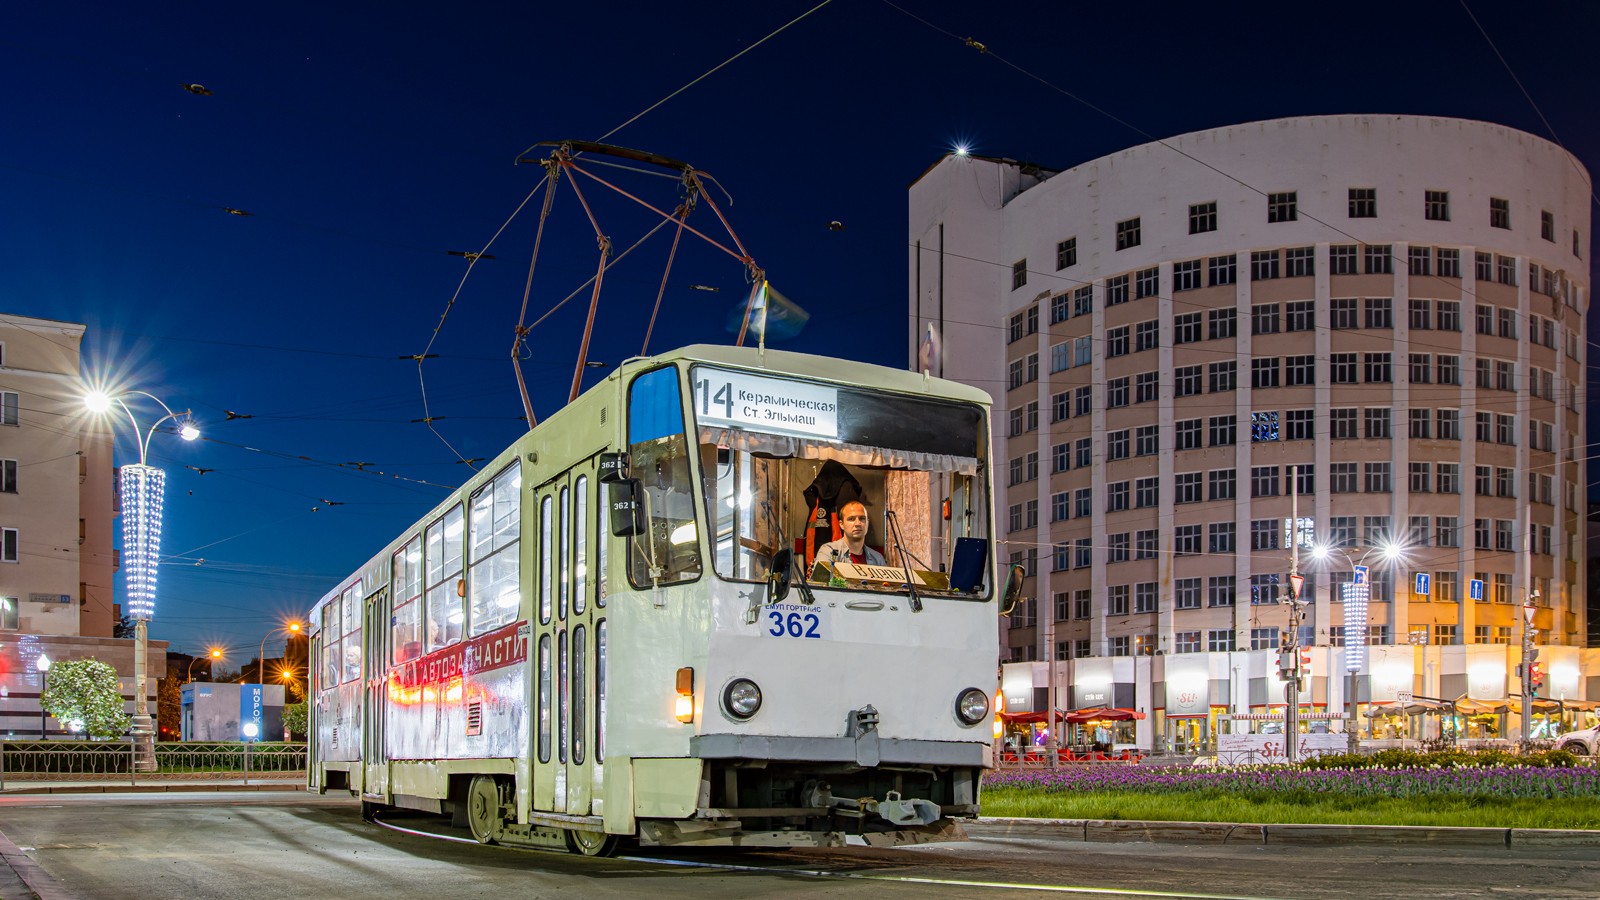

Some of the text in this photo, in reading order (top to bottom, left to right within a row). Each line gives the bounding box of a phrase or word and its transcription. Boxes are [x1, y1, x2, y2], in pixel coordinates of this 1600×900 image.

[696, 378, 734, 418] 14
[738, 389, 836, 413] Керамическая
[743, 405, 816, 426] Ст. Эльмаш
[601, 461, 615, 469] 362
[614, 501, 629, 510] 362
[765, 602, 785, 611] ЕМУП
[768, 611, 821, 639] 362
[1399, 693, 1412, 701] СТОП
